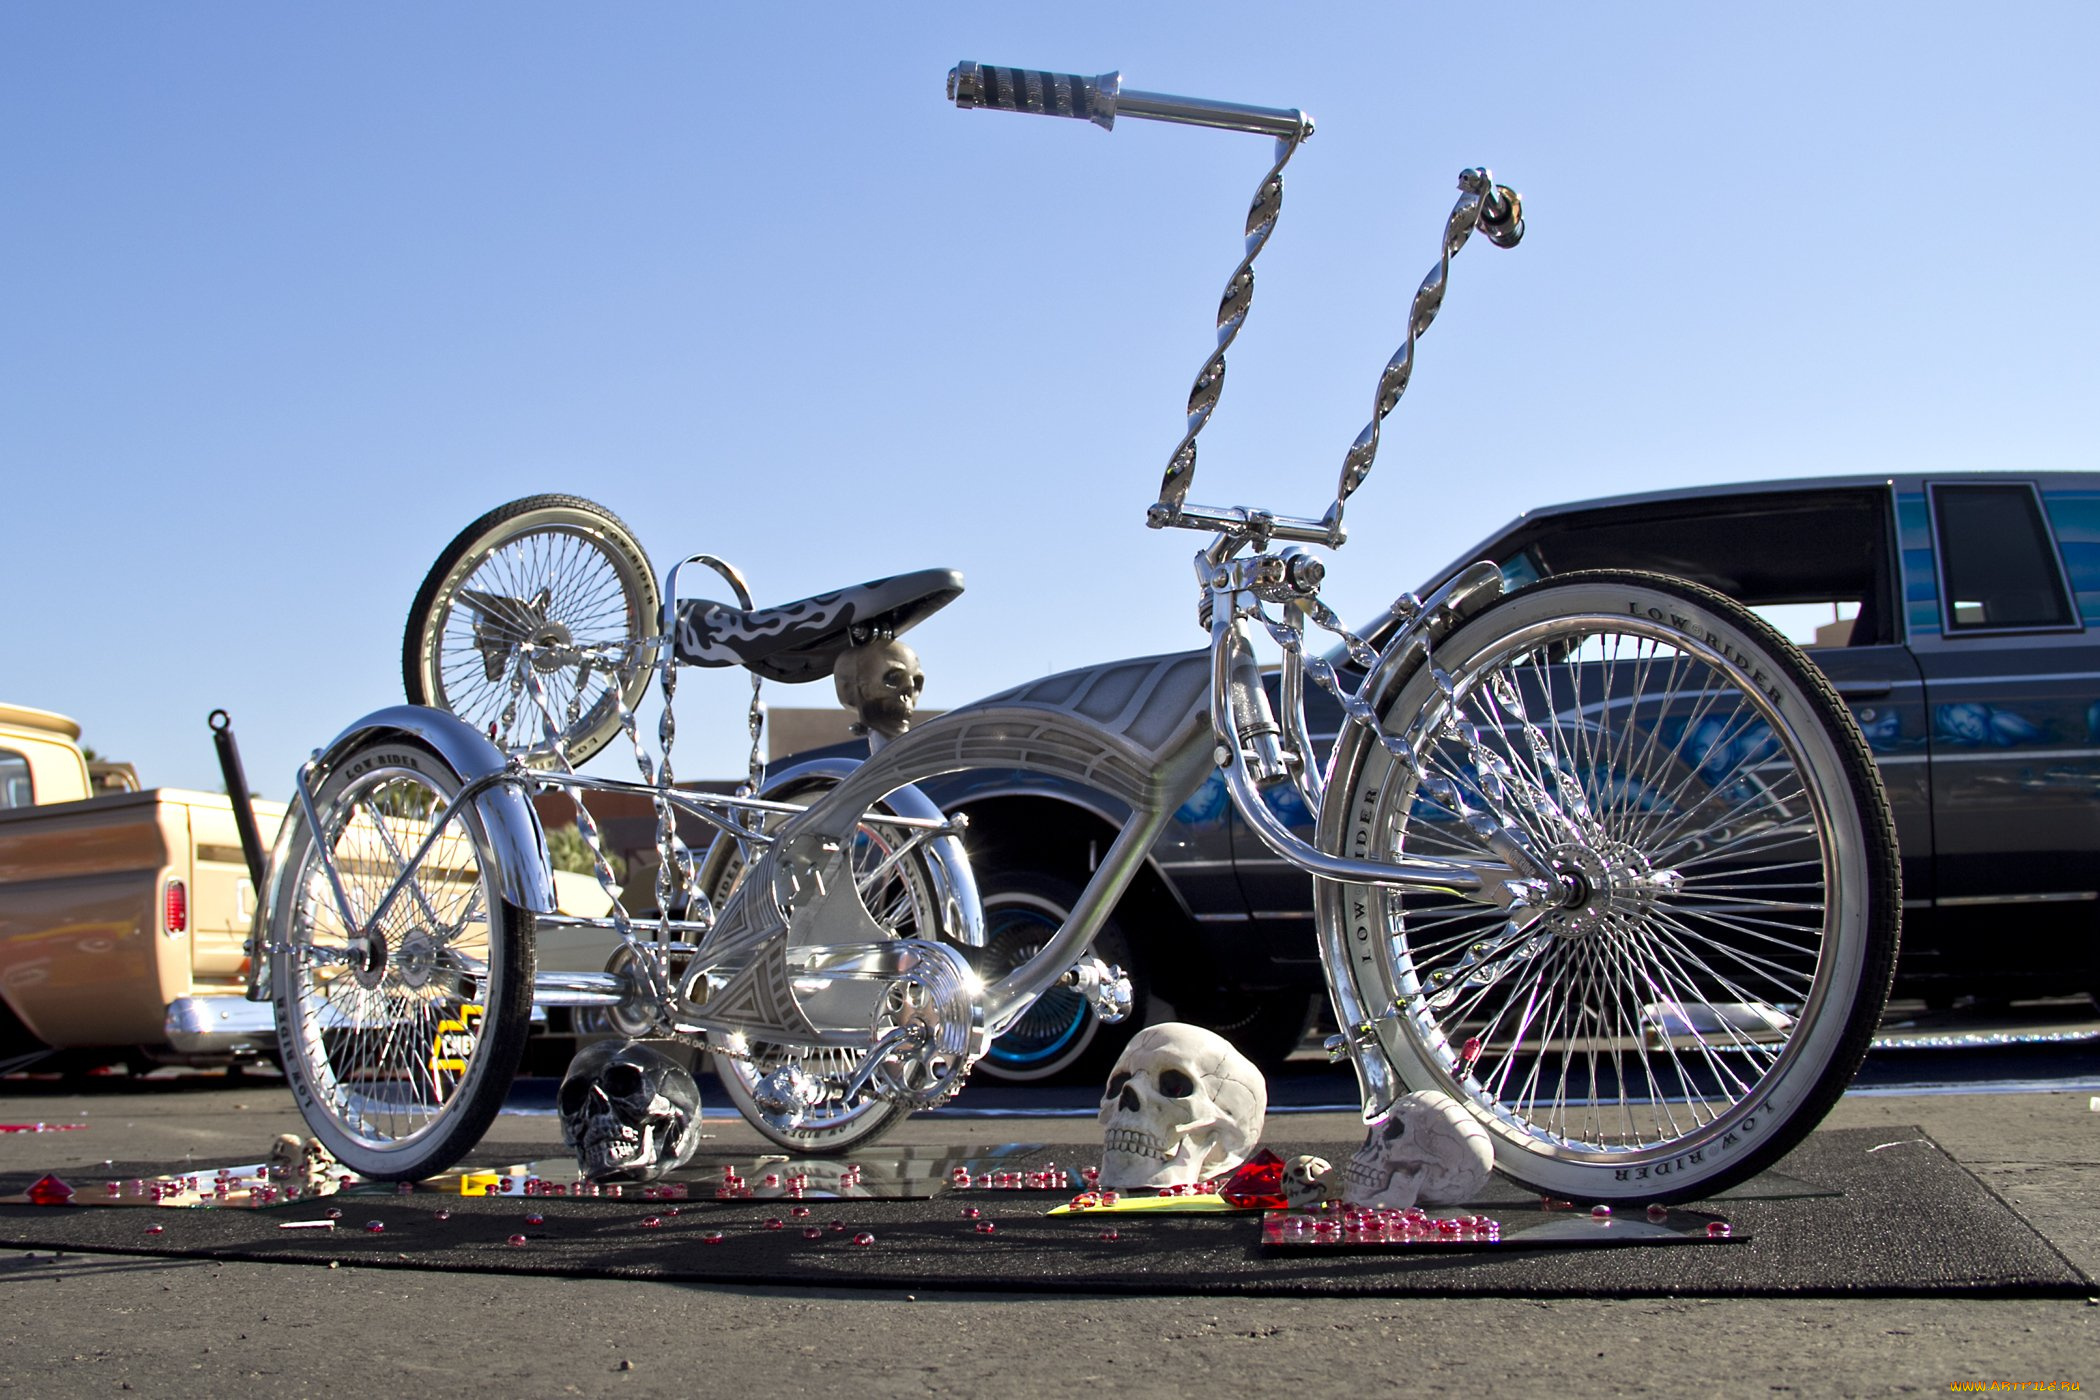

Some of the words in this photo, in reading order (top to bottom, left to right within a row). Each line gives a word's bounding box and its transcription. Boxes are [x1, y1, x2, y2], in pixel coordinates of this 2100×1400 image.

[1629, 602, 1688, 629] LOW
[1705, 631, 1783, 707] RIDER
[345, 757, 373, 779] LOW
[378, 754, 418, 769] RIDER
[1354, 789, 1379, 859] IDER
[1353, 901, 1373, 963] LOW
[277, 996, 295, 1062] RIDER
[291, 1071, 313, 1109] LOW
[1713, 1102, 1775, 1150] LOW
[1615, 1154, 1706, 1182] RIDER
